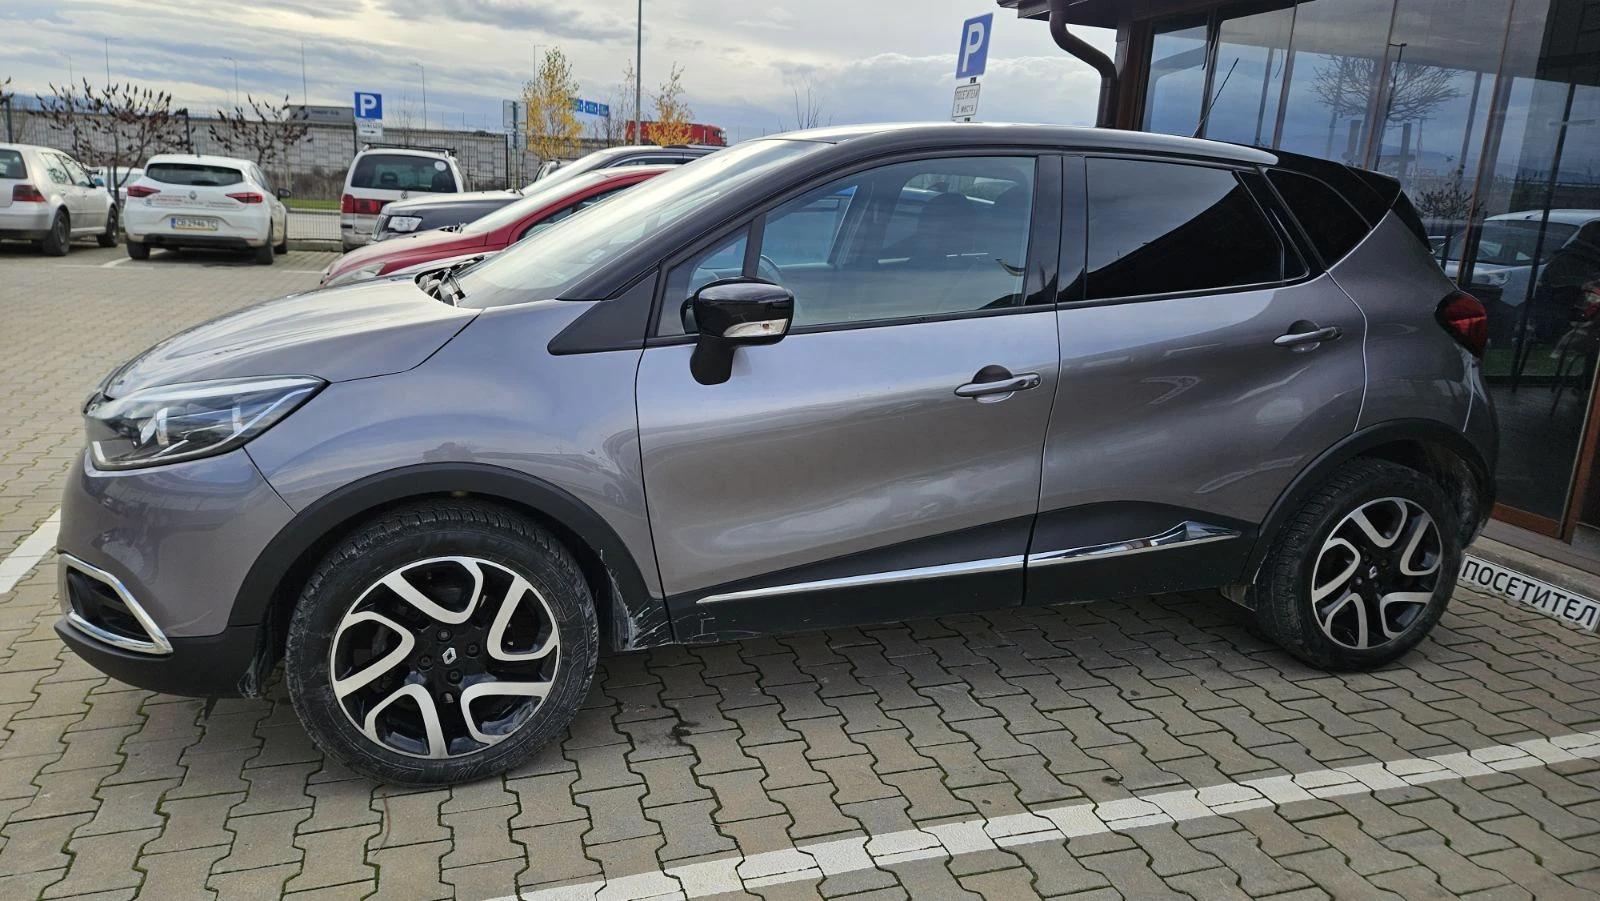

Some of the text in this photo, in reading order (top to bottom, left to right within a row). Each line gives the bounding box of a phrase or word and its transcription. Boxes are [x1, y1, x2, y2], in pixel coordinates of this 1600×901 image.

[962, 22, 985, 73] P
[360, 94, 377, 117] P
[1462, 560, 1598, 627] ПОСЕТИТЕЛ
